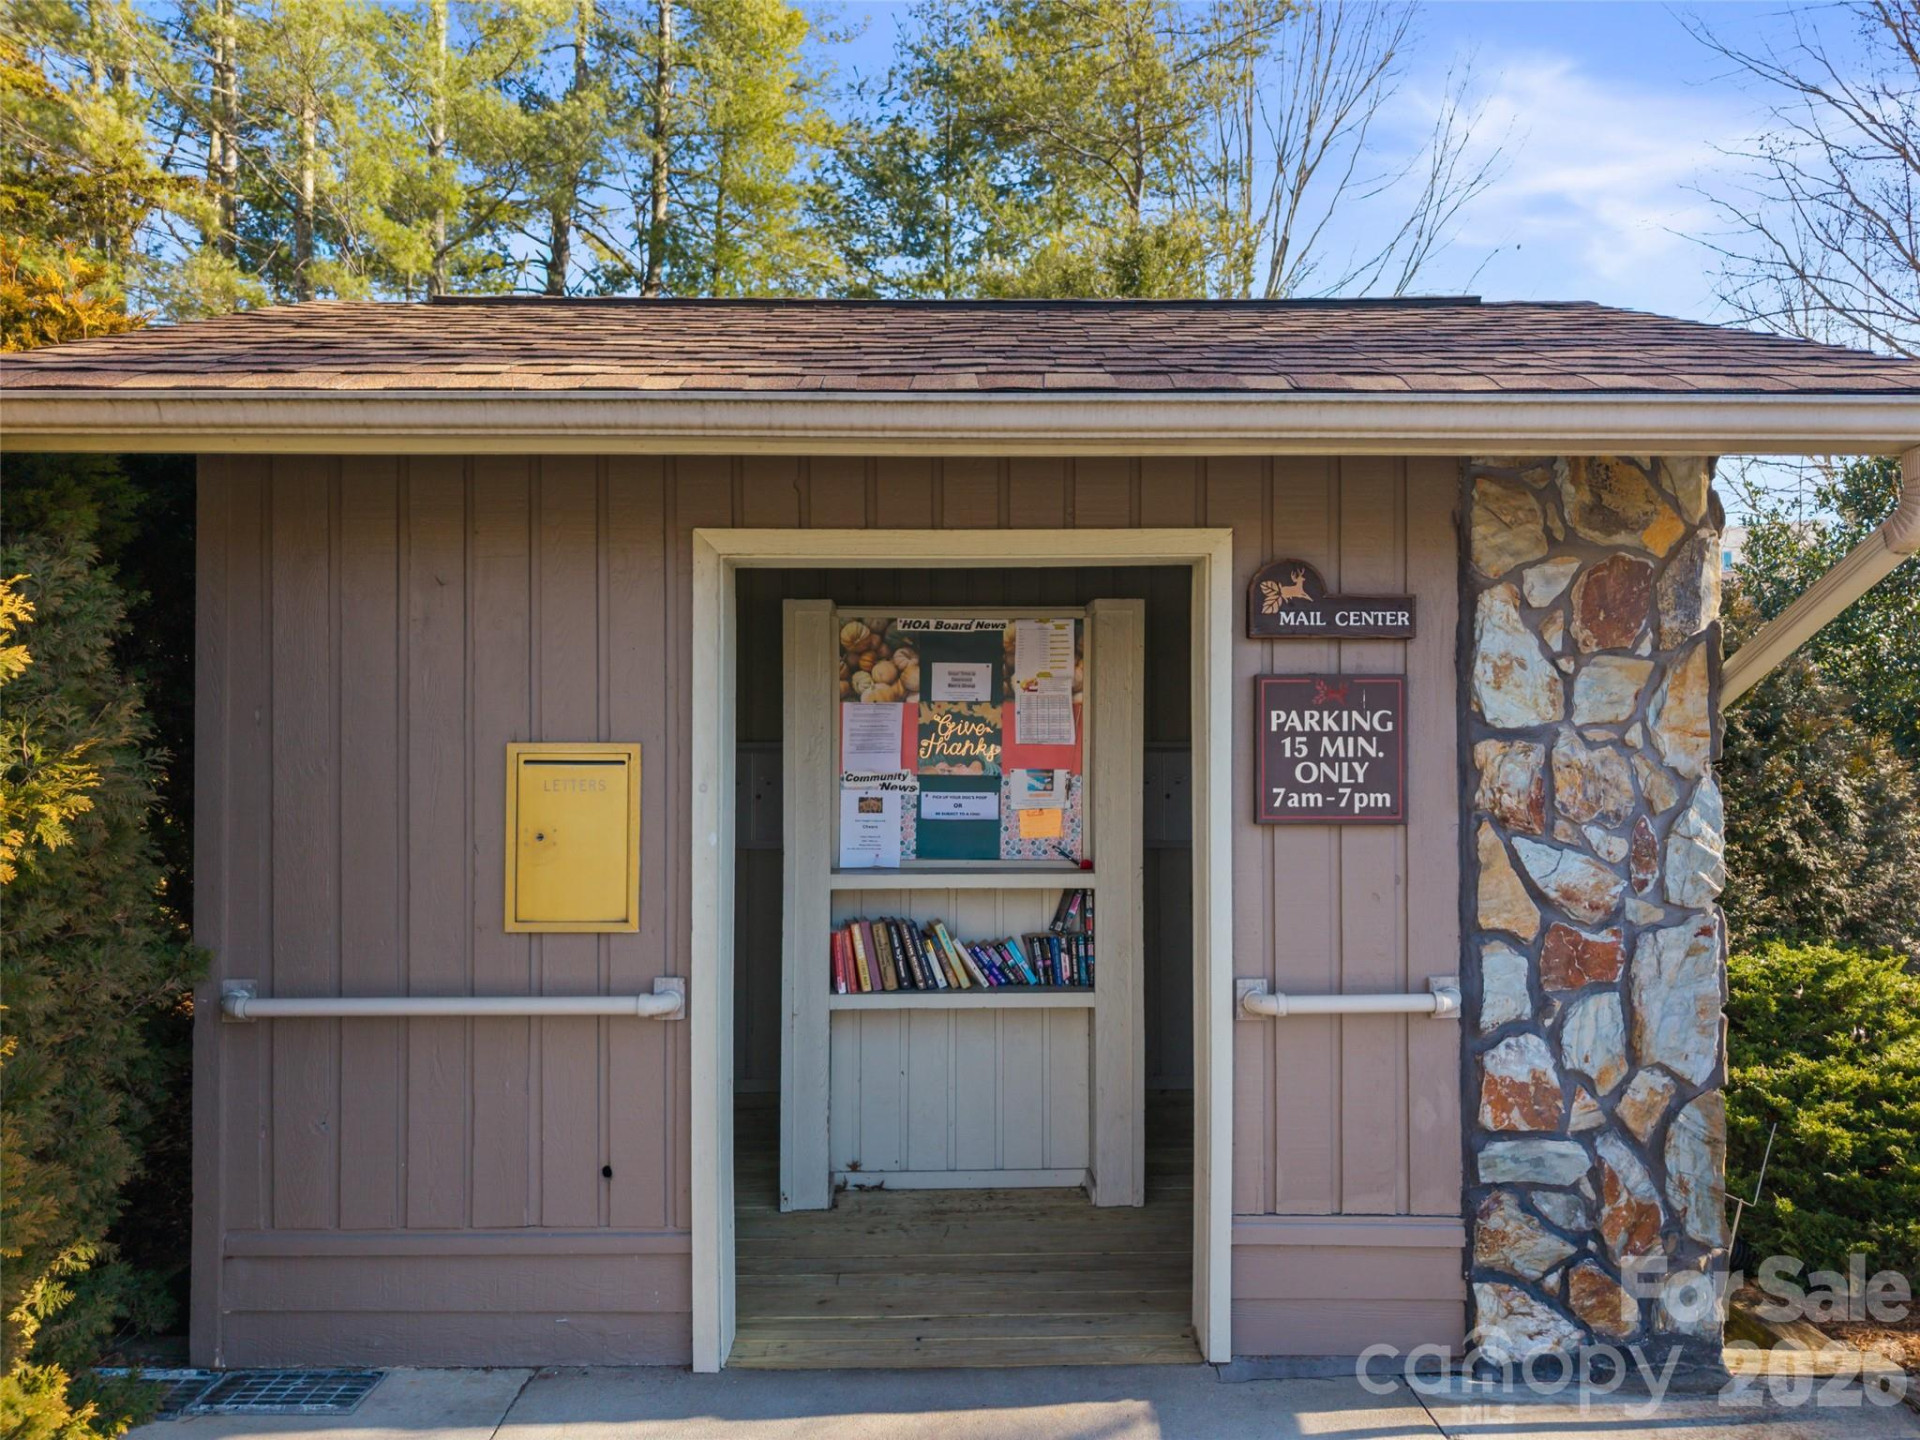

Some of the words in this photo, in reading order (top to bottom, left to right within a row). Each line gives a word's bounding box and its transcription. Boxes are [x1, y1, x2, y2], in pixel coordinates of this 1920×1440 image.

[902, 620, 931, 630] HOA
[934, 620, 973, 631] Board
[974, 621, 1007, 630] News
[1279, 611, 1326, 626] MAIL
[1335, 611, 1410, 626] CENTER
[933, 713, 994, 741] Give
[1270, 710, 1393, 732] PARKING
[1281, 736, 1308, 758] 15
[1319, 736, 1385, 758] MIN.
[845, 770, 909, 782] Community
[1294, 761, 1369, 784] ONLY
[543, 779, 608, 793] LETTERS
[879, 782, 918, 793] News
[1272, 788, 1392, 814] 7am-7pm
